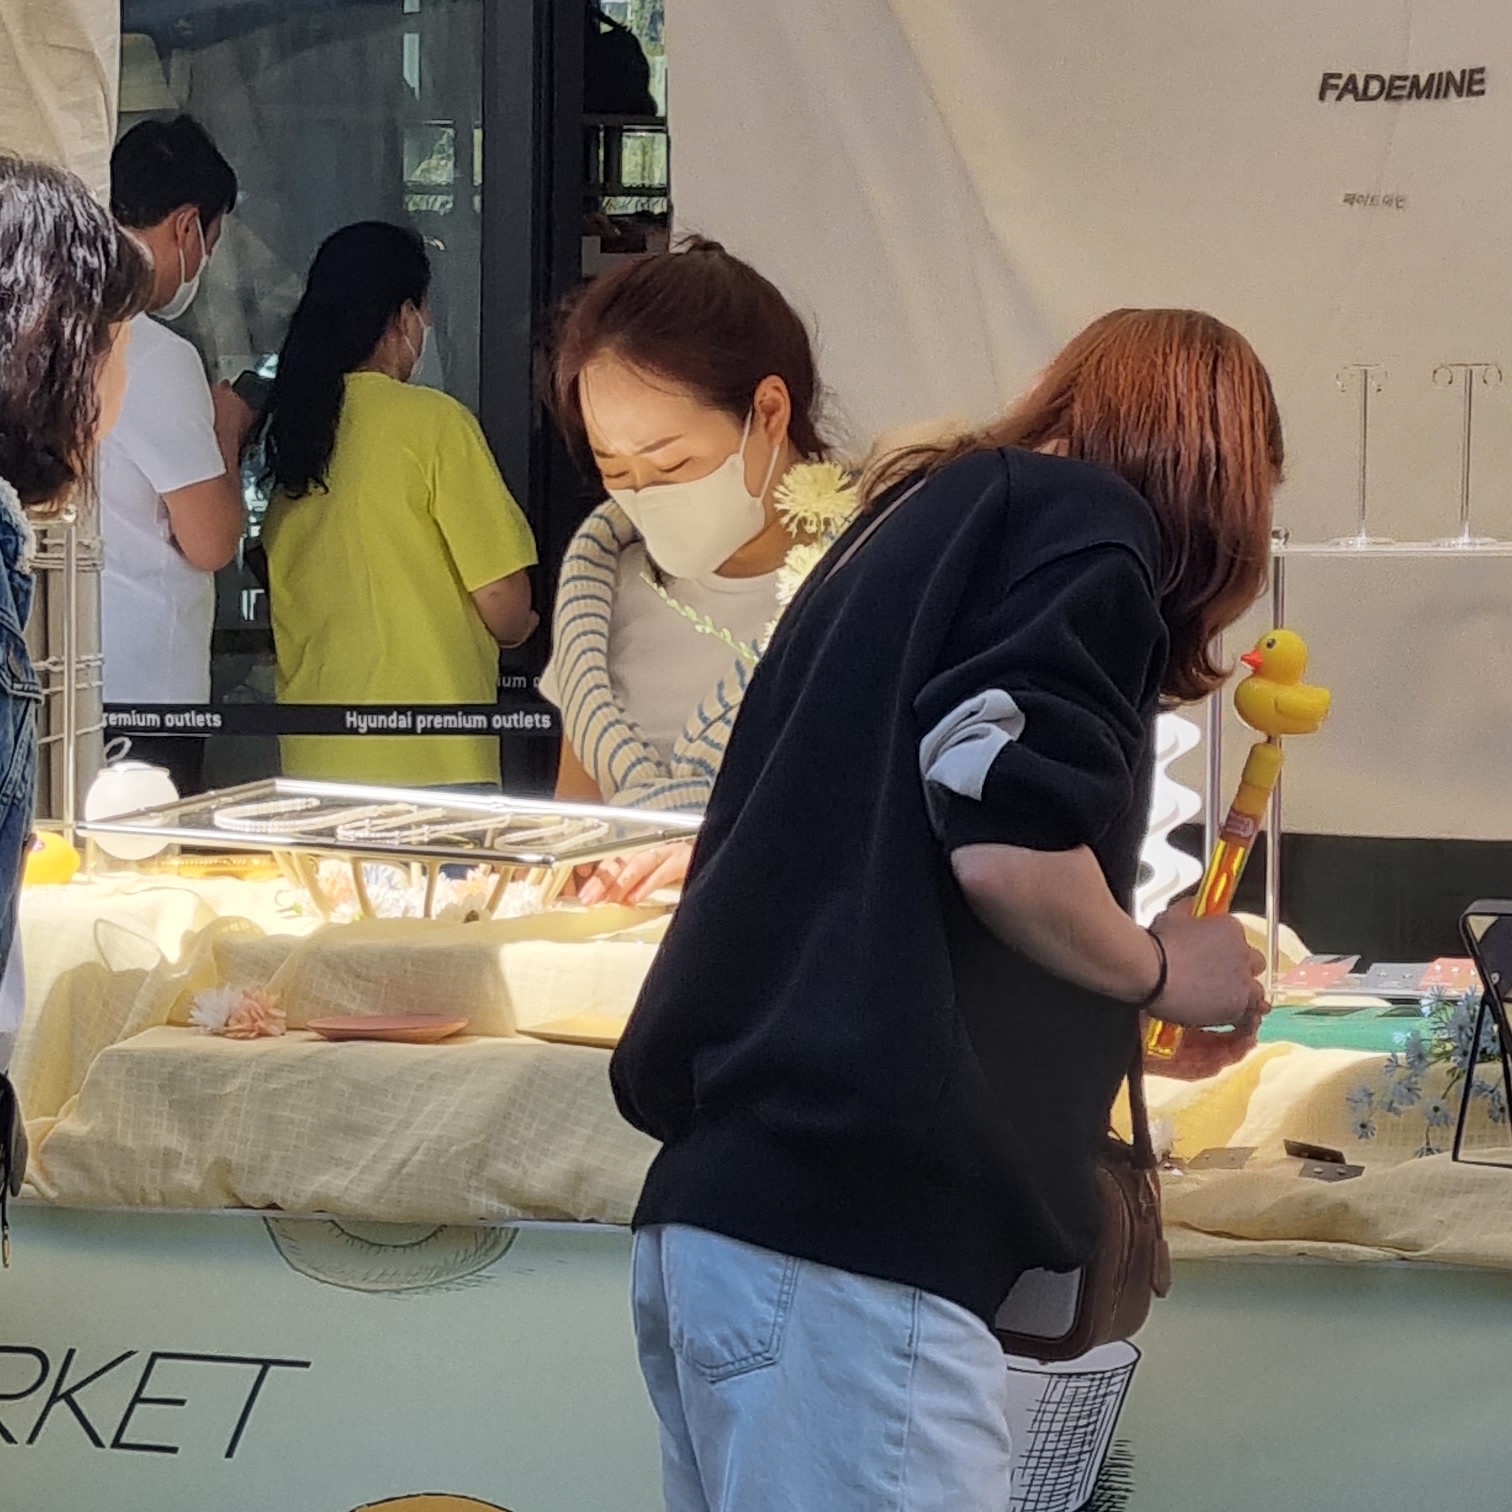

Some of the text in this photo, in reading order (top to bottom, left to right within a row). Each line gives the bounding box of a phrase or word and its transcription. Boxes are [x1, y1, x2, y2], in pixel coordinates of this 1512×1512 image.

[1318, 66, 1486, 102] FADEMINE
[103, 710, 222, 728] remium outlets
[345, 711, 552, 734] Hyundai premium outlets
